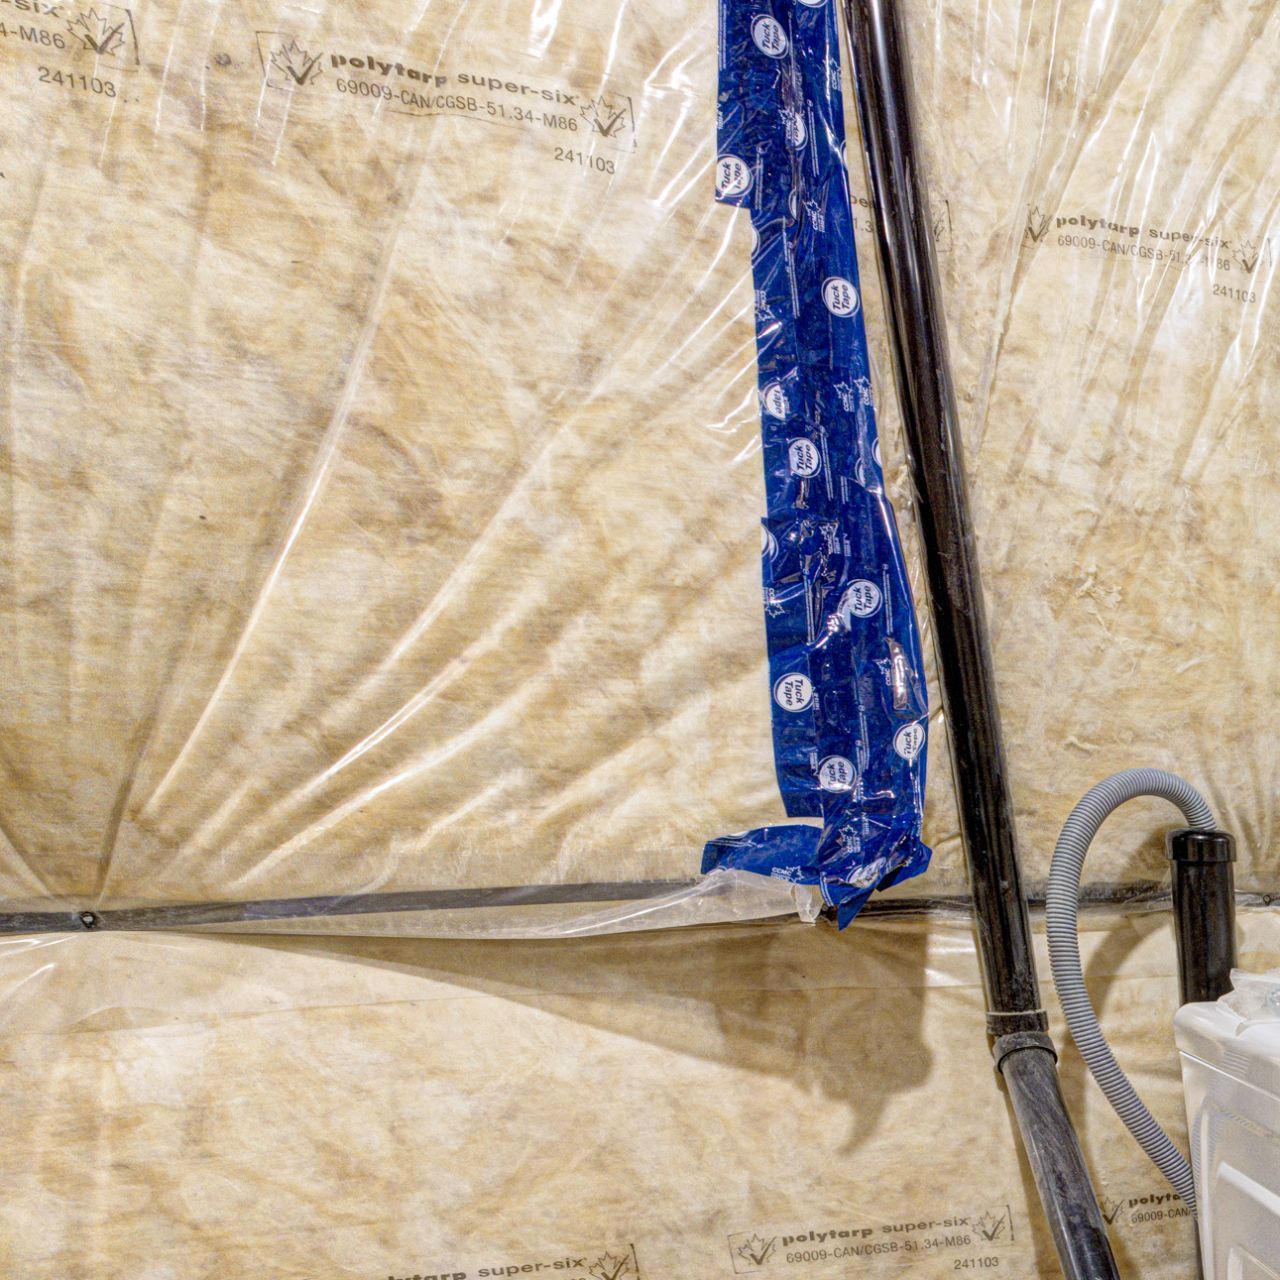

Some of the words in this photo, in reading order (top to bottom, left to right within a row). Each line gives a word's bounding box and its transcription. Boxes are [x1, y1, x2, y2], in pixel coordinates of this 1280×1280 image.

[761, 22, 770, 49] Tuck
[37, 66, 117, 98] 241103
[330, 54, 447, 88] polytarp
[336, 78, 579, 132] 69009-CAN/CGSB-51.34-M86
[553, 146, 616, 175] 241103
[1056, 215, 1140, 238] polytarp
[832, 284, 841, 311] Tuck
[842, 284, 850, 310] Tape
[805, 444, 813, 470] Tape
[854, 587, 863, 612] Tuck
[864, 586, 872, 610] Tape
[785, 681, 793, 705] Tape
[795, 679, 804, 704] Tuck
[782, 1228, 873, 1247] polytarp
[882, 1216, 969, 1233] super-six
[786, 1234, 971, 1263] 69009-CAN/CGSB-51.34-M86
[478, 1257, 584, 1278] super-six
[954, 1256, 999, 1269] 241103
